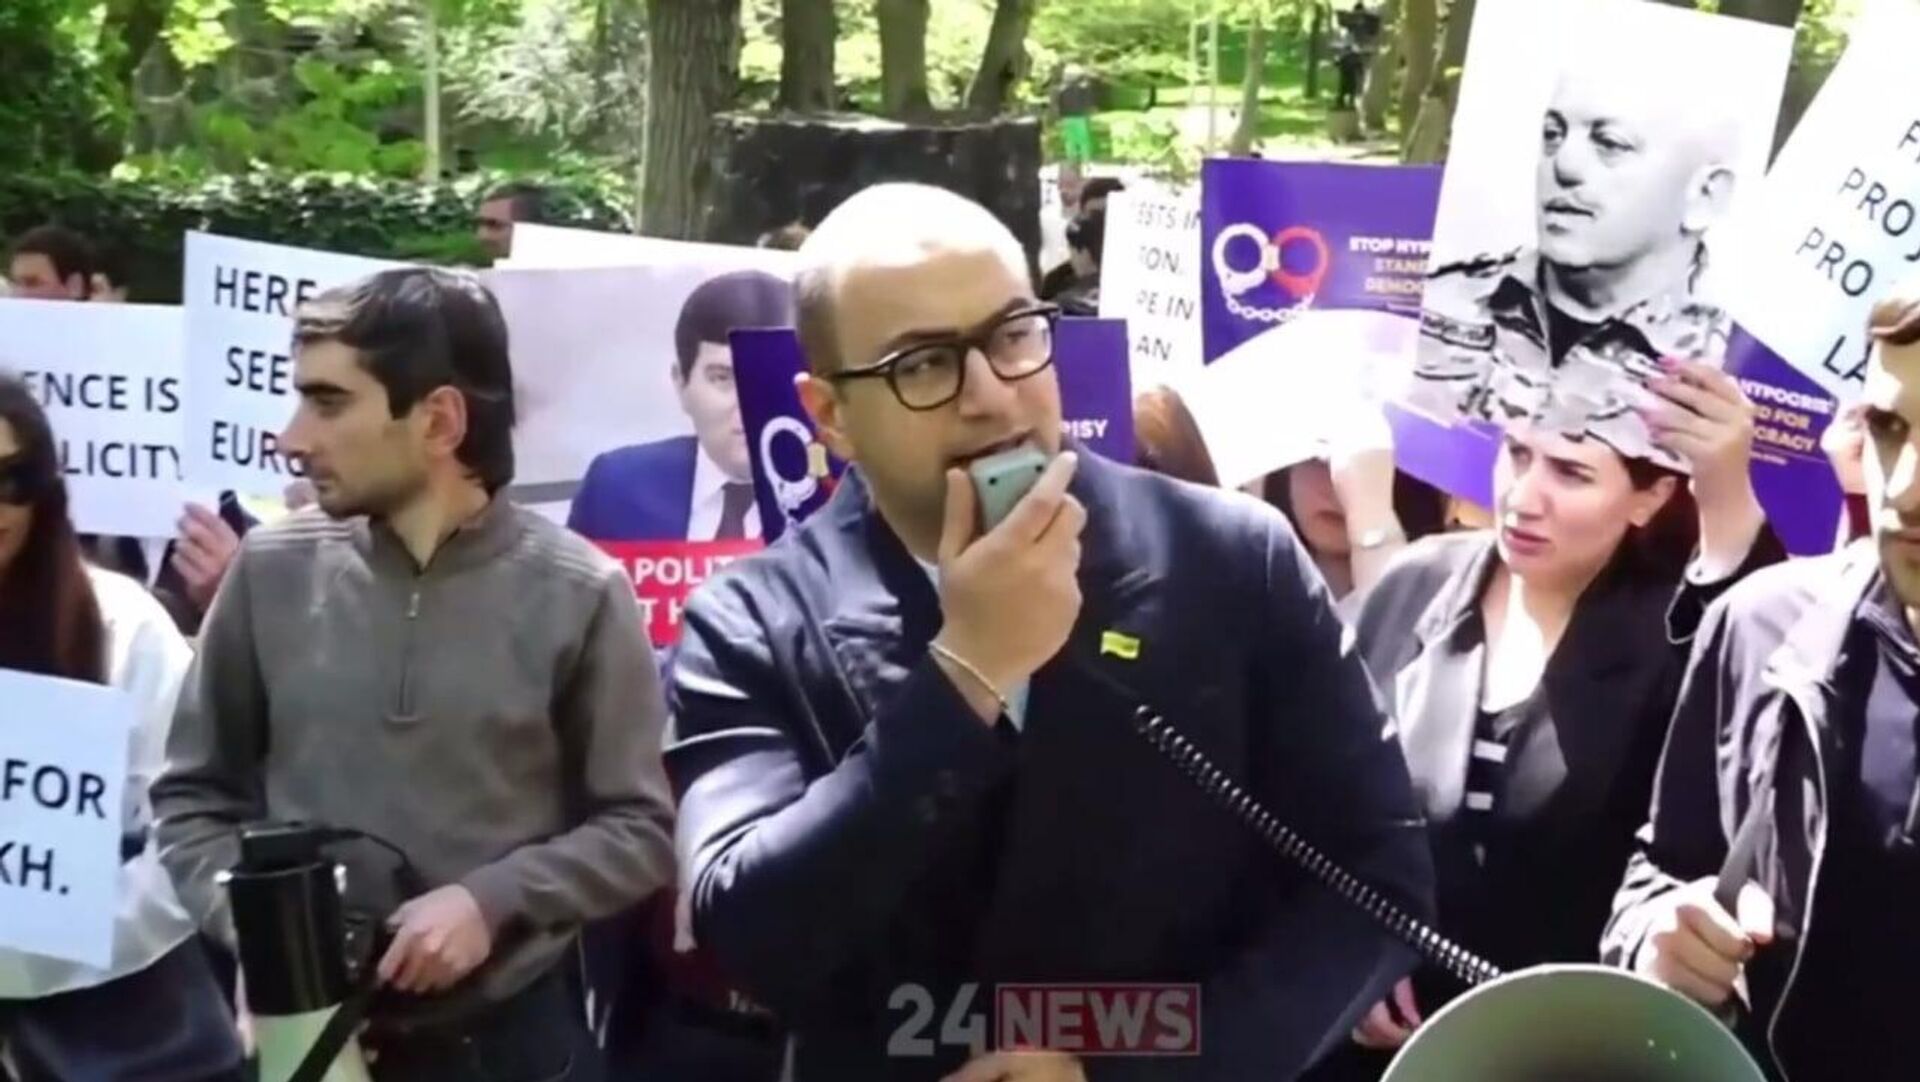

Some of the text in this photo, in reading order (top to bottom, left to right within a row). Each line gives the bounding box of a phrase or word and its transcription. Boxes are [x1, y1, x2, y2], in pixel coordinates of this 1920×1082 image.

[1838, 166, 1916, 238] PRO
[1349, 236, 1394, 253] STOP
[1795, 226, 1874, 298] PRO
[213, 265, 317, 318] HERE
[1166, 297, 1195, 320] IN
[145, 376, 180, 413] IS
[225, 346, 289, 396] SEE
[2, 758, 107, 820] FOR
